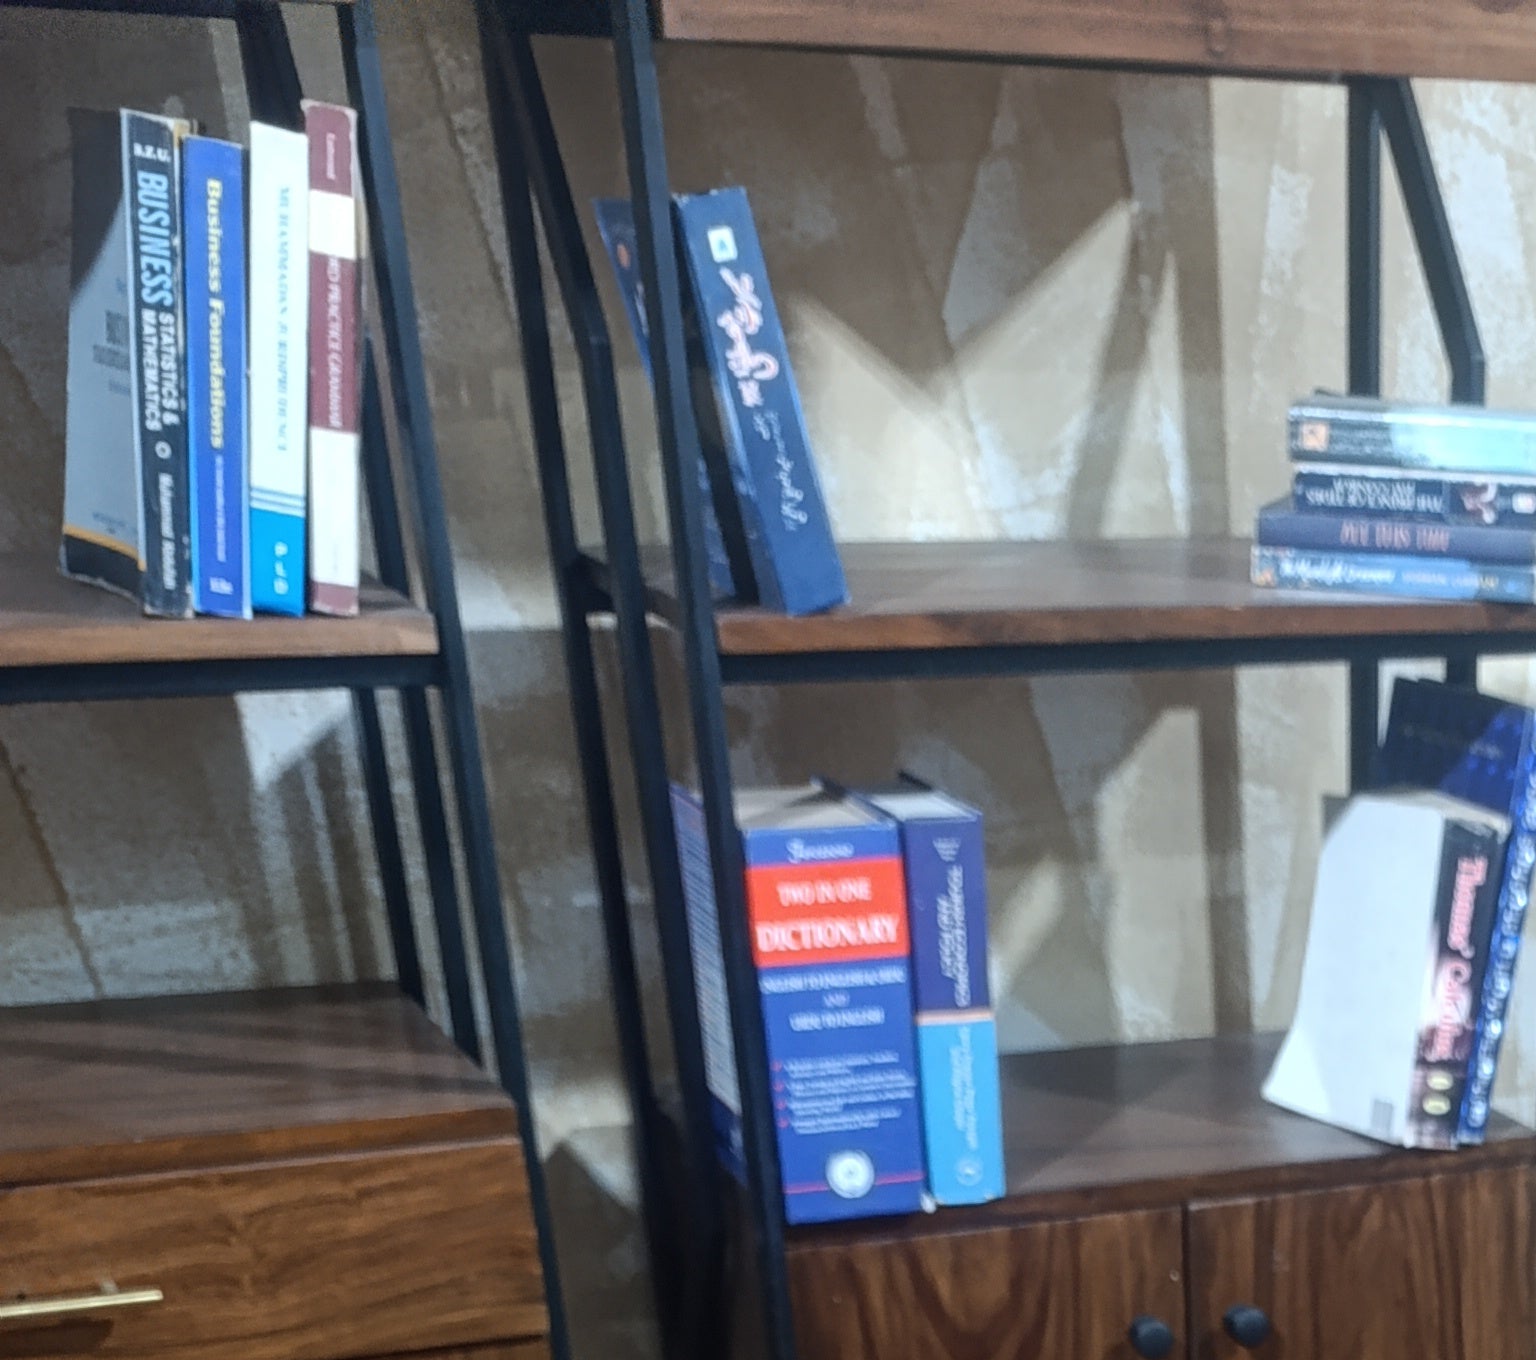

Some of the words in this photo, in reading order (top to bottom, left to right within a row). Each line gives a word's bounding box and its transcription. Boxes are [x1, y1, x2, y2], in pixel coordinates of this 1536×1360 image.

[136, 169, 173, 307] BUSINESS
[205, 179, 223, 290] Business
[140, 308, 163, 431] MATHEMATICS
[158, 310, 181, 411] STATISTICS
[208, 292, 226, 450] Foundations
[755, 914, 899, 953] DICTIONARY
[776, 880, 815, 907] TWO
[815, 879, 837, 904] IN
[836, 876, 872, 903] ONE
